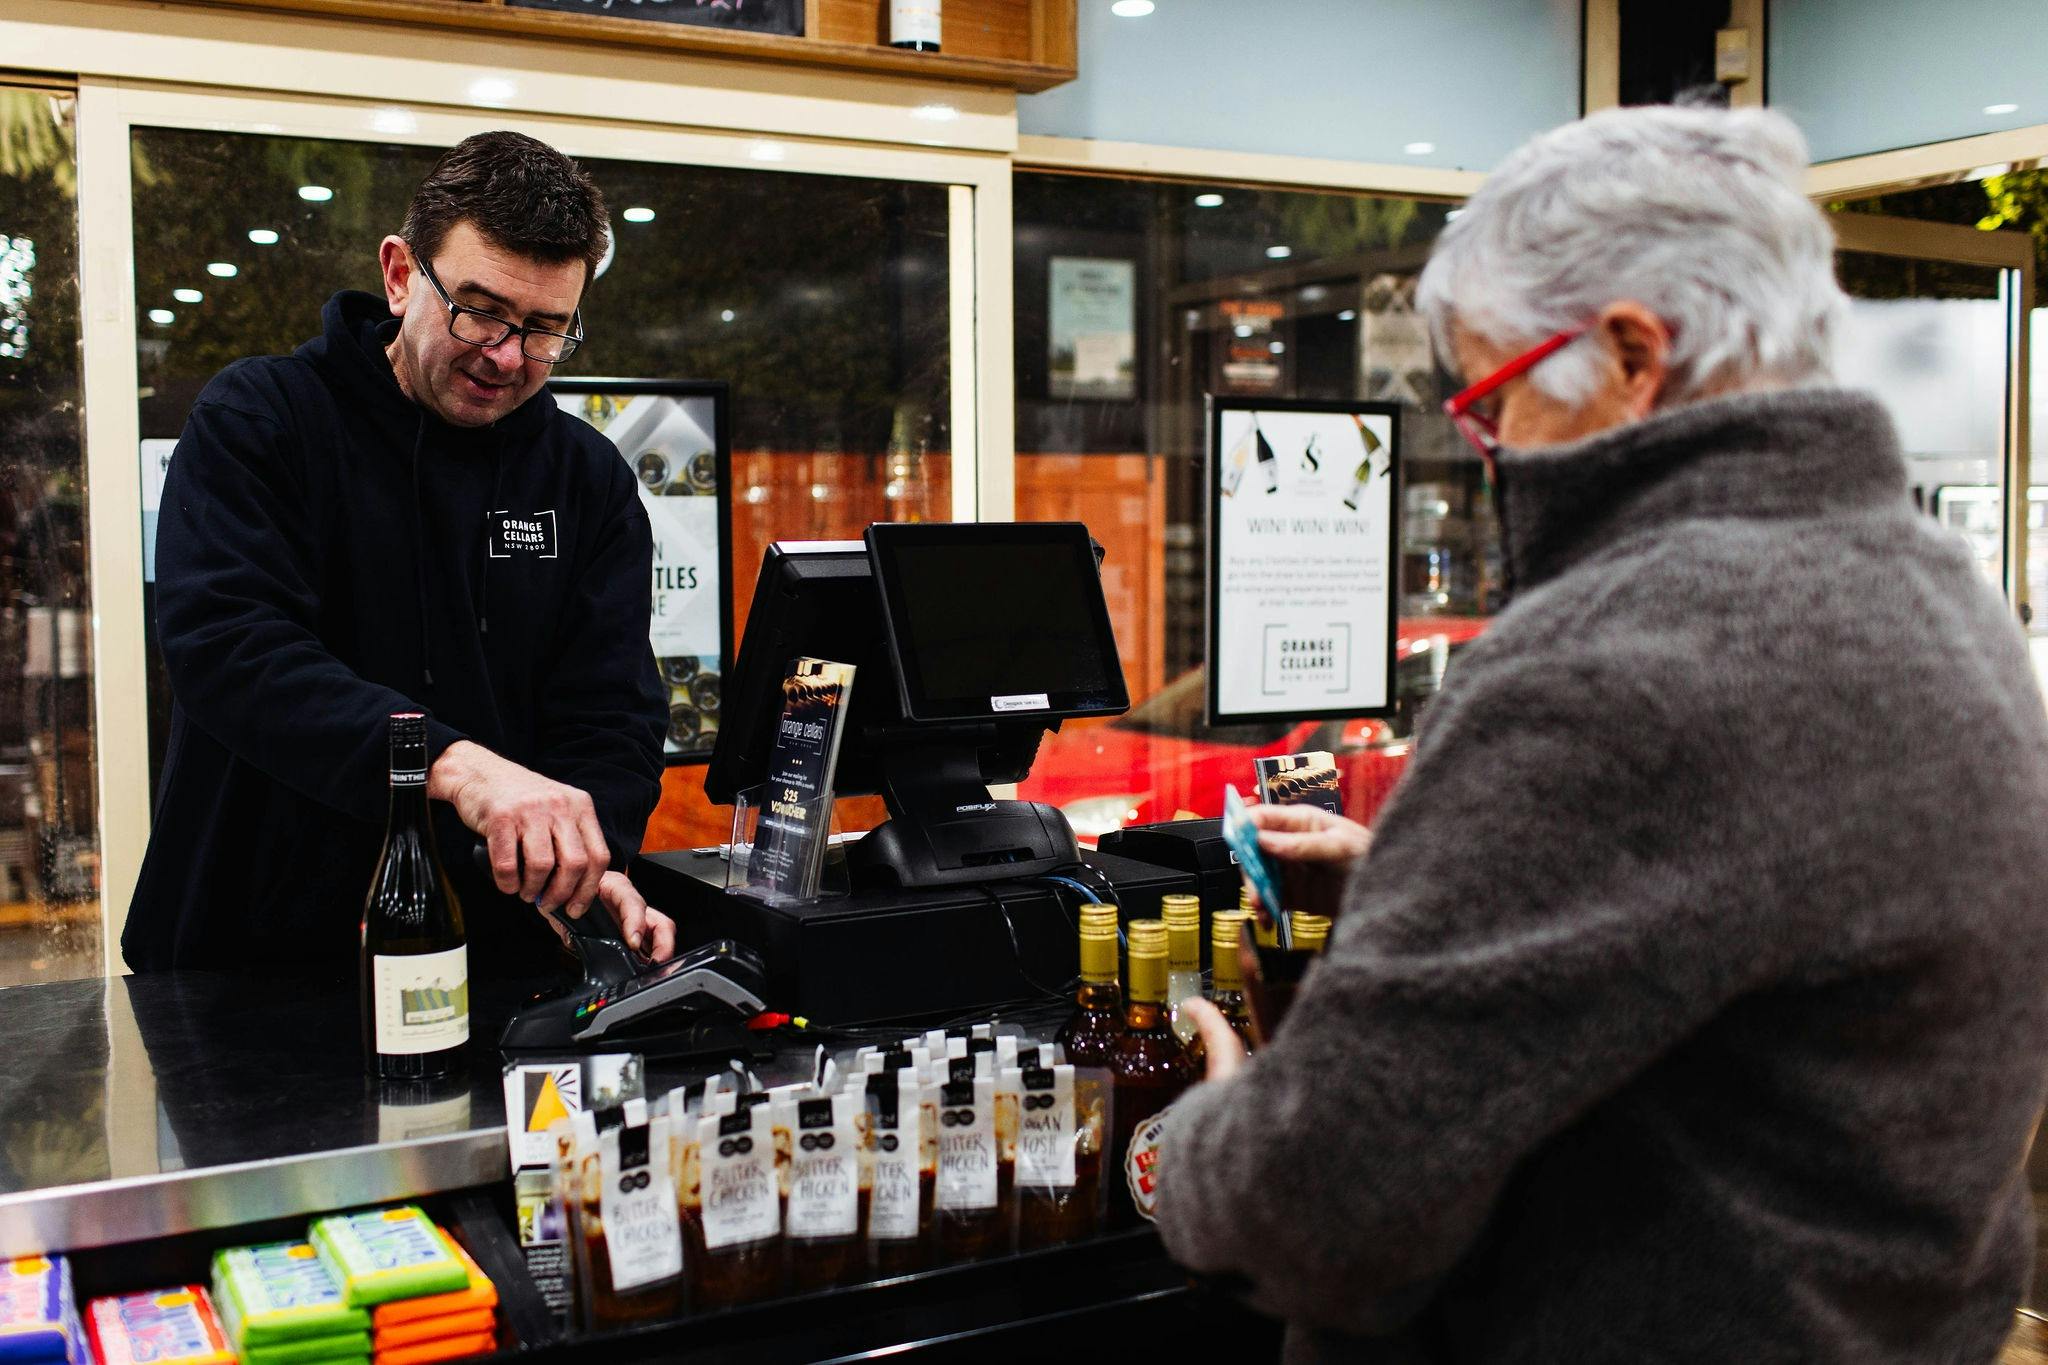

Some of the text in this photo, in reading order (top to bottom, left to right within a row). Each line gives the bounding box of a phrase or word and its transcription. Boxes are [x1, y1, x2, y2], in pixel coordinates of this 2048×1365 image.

[502, 519, 543, 532] ORANGE
[503, 531, 545, 543] CELLARS
[504, 542, 546, 551] NSW 2800
[1281, 639, 1334, 652] ORANGE
[1280, 656, 1334, 669] CELLARS
[782, 719, 824, 740] orange cellars
[783, 788, 799, 803] $25
[941, 1153, 989, 1173] HICKEN
[800, 1179, 849, 1200] HICKEN
